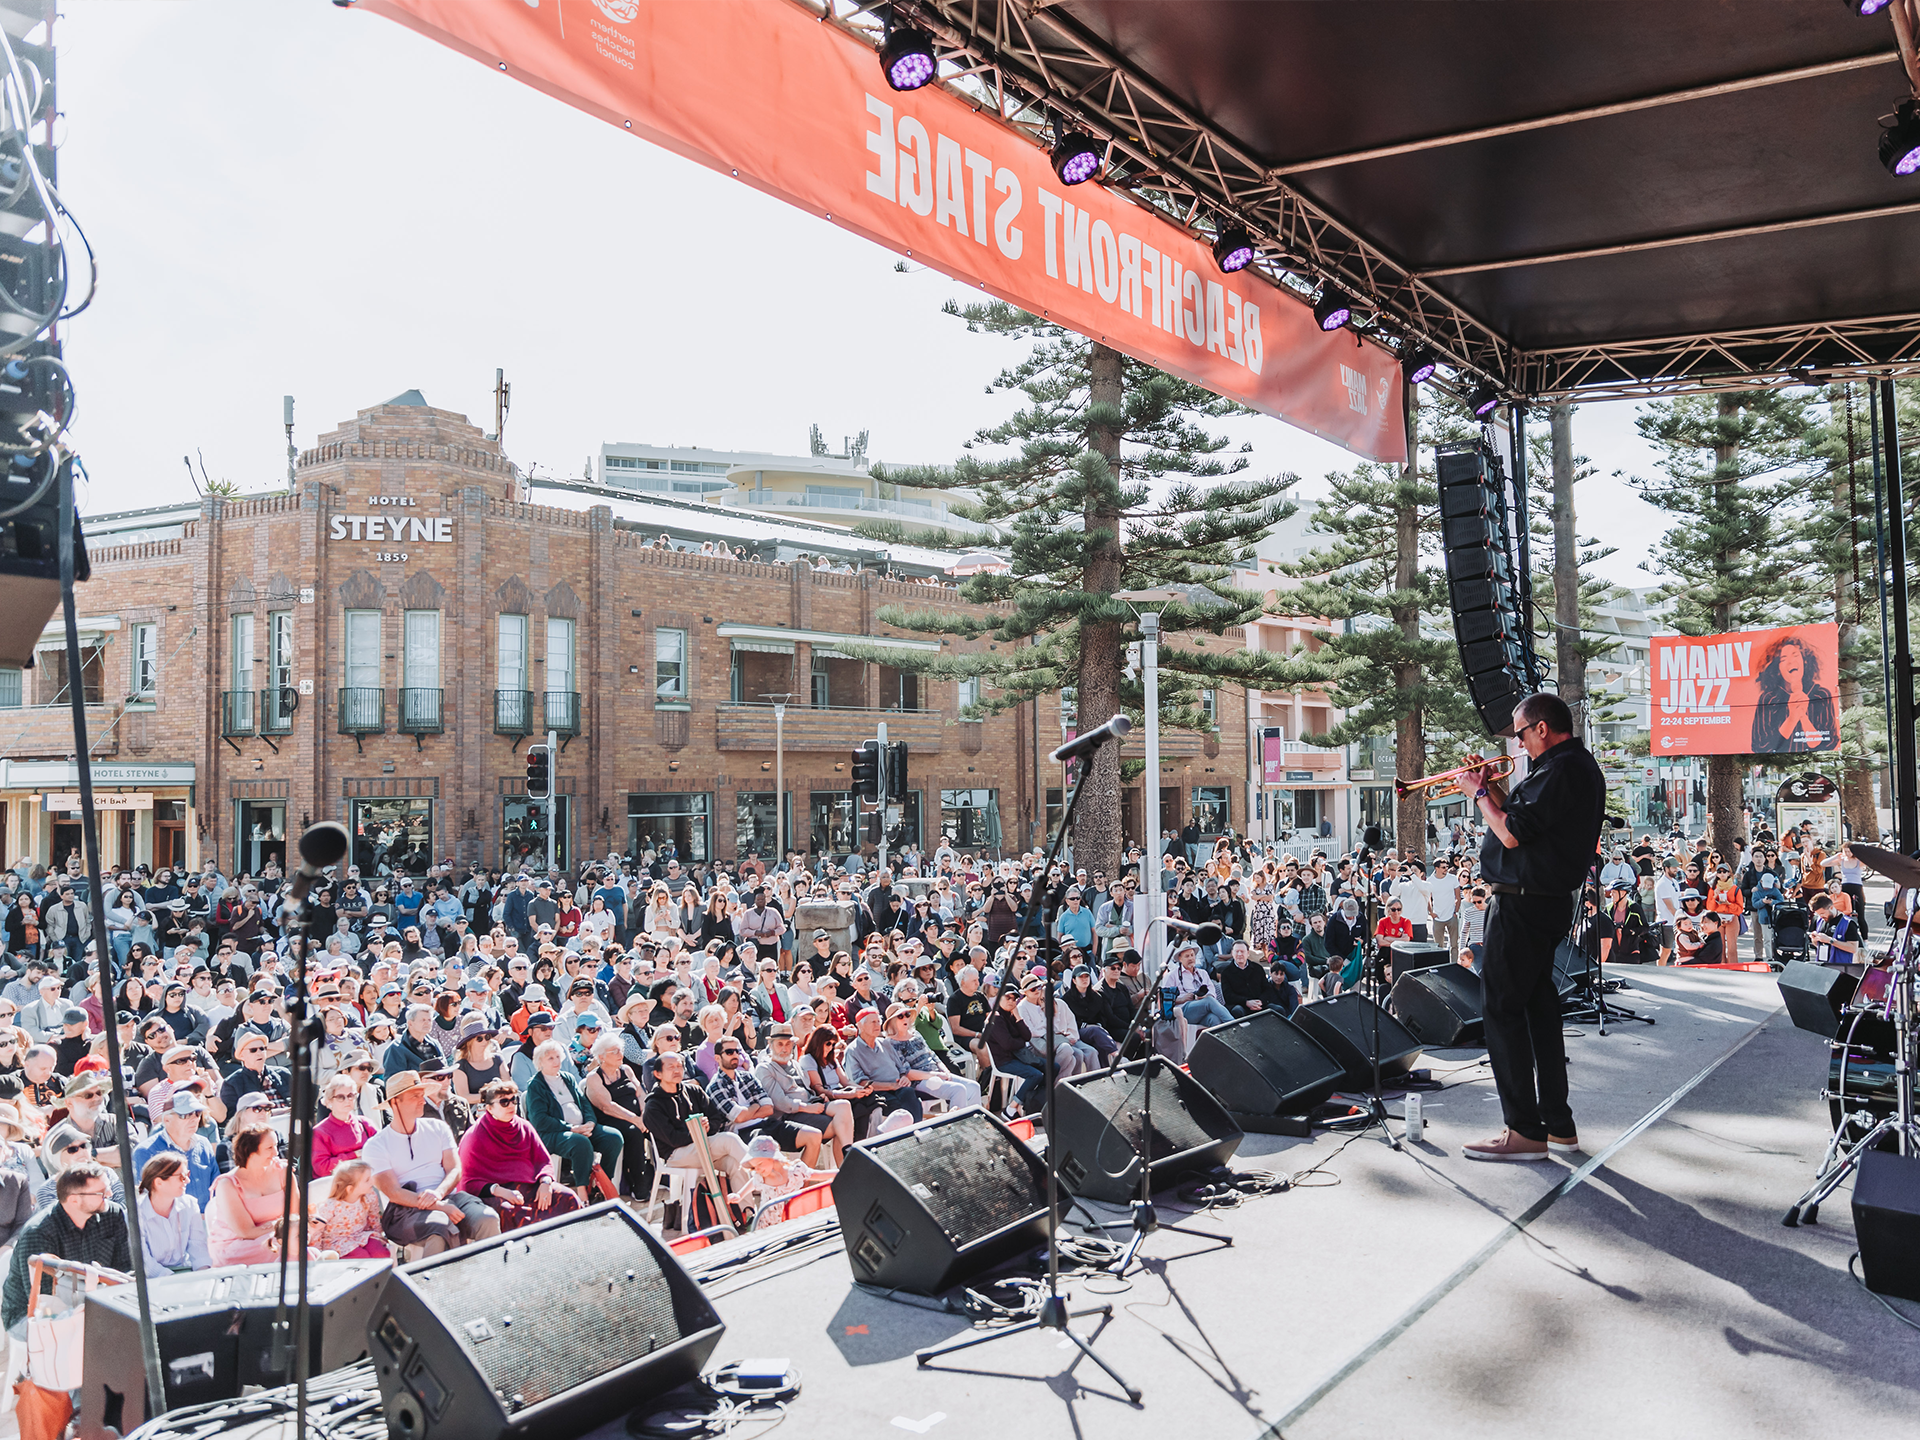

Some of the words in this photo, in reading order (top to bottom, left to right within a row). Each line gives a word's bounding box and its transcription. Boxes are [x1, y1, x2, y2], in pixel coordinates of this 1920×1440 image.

[368, 496, 416, 506] HOTEL
[330, 514, 453, 542] STEYNE
[376, 552, 409, 562] 1859
[1660, 641, 1752, 680] MANLY
[1660, 678, 1731, 714] JAZZ
[1660, 717, 1683, 726] 22-24
[1683, 716, 1731, 725] SEPTEMBER
[94, 769, 124, 778] HOTEL
[126, 769, 160, 778] STEYNE
[77, 797, 107, 805] BCH
[110, 797, 127, 805] BAR
